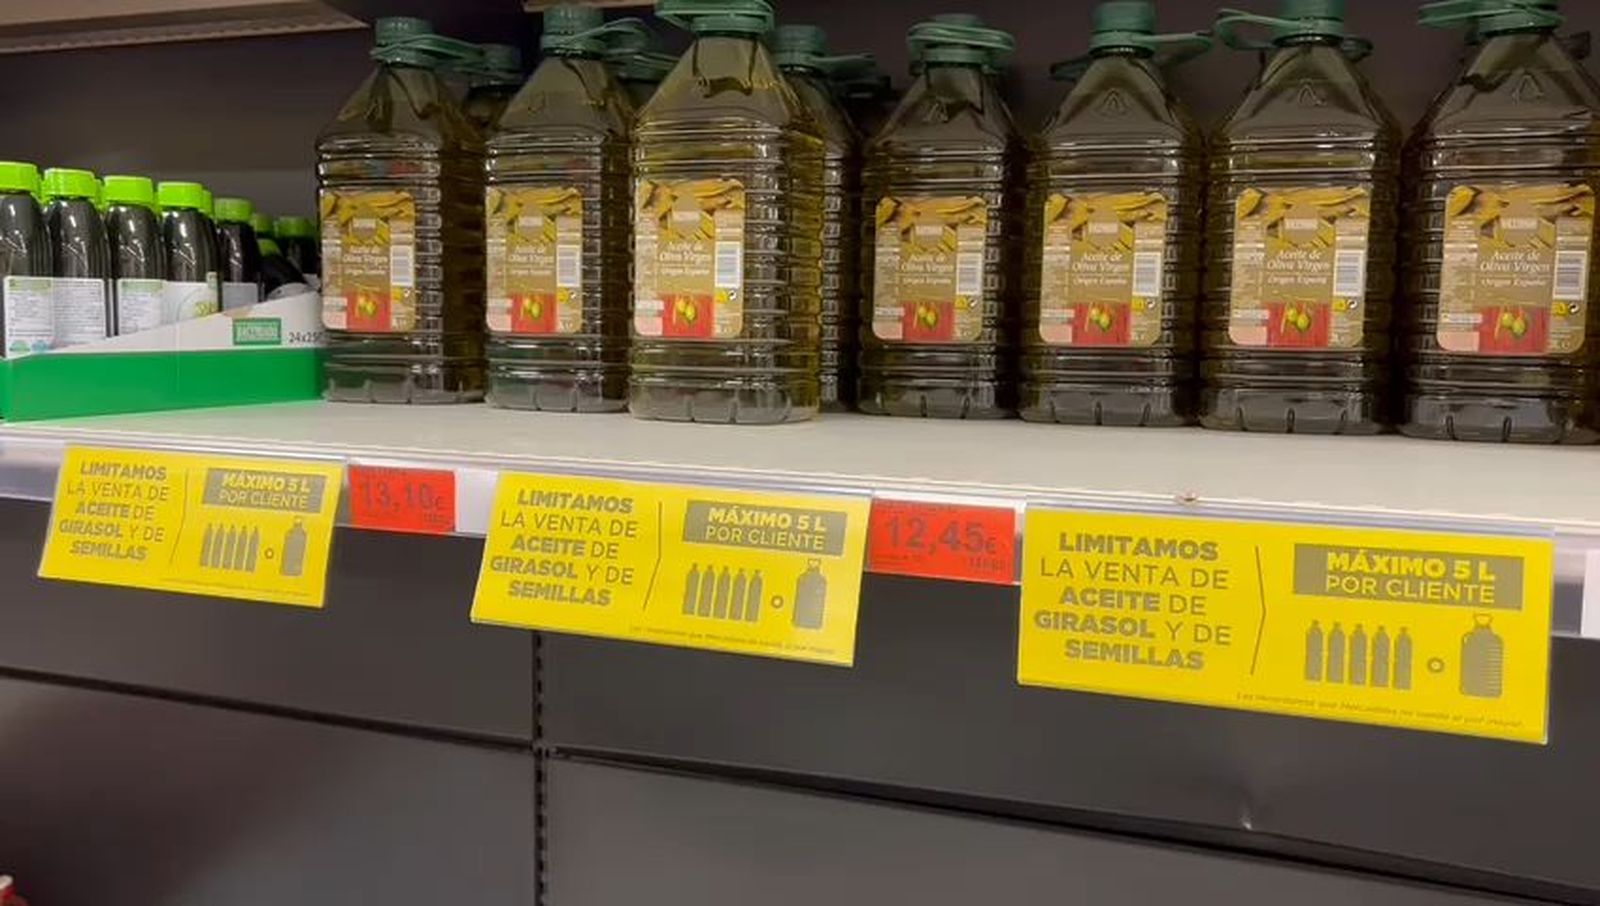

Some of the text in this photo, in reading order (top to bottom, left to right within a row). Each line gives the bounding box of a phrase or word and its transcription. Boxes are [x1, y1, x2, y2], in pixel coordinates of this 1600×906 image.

[80, 462, 166, 481] LIMITAMOS
[221, 471, 311, 493] MÁXIMO 5 L
[67, 482, 170, 502] LA VENTA DE
[219, 489, 308, 510] POR CLIENTE
[517, 489, 633, 514] LIMITAMOS
[75, 502, 155, 521] ACEITE DE
[500, 510, 638, 538] LA VENTA DE
[708, 505, 827, 533] MÁXIMO 5 L
[59, 522, 165, 543] GIRASOL Y DE
[705, 526, 825, 551] POR CLIENTE
[69, 540, 148, 561] SEMILLAS
[511, 534, 619, 560] ACEITE DE
[1058, 532, 1220, 562] LIMITAMOS
[489, 556, 634, 586] GIRASOL Y DE
[1040, 558, 1230, 590] LA VENTA DE
[1326, 546, 1495, 582] MÁXIMO 5 L
[508, 579, 611, 606] SEMILLAS
[1058, 587, 1207, 616] ACEITE DE
[1325, 573, 1496, 605] POR CLIENTE
[1033, 610, 1232, 646] GIRASOL Y DE
[1064, 638, 1206, 671] SEMILLAS
